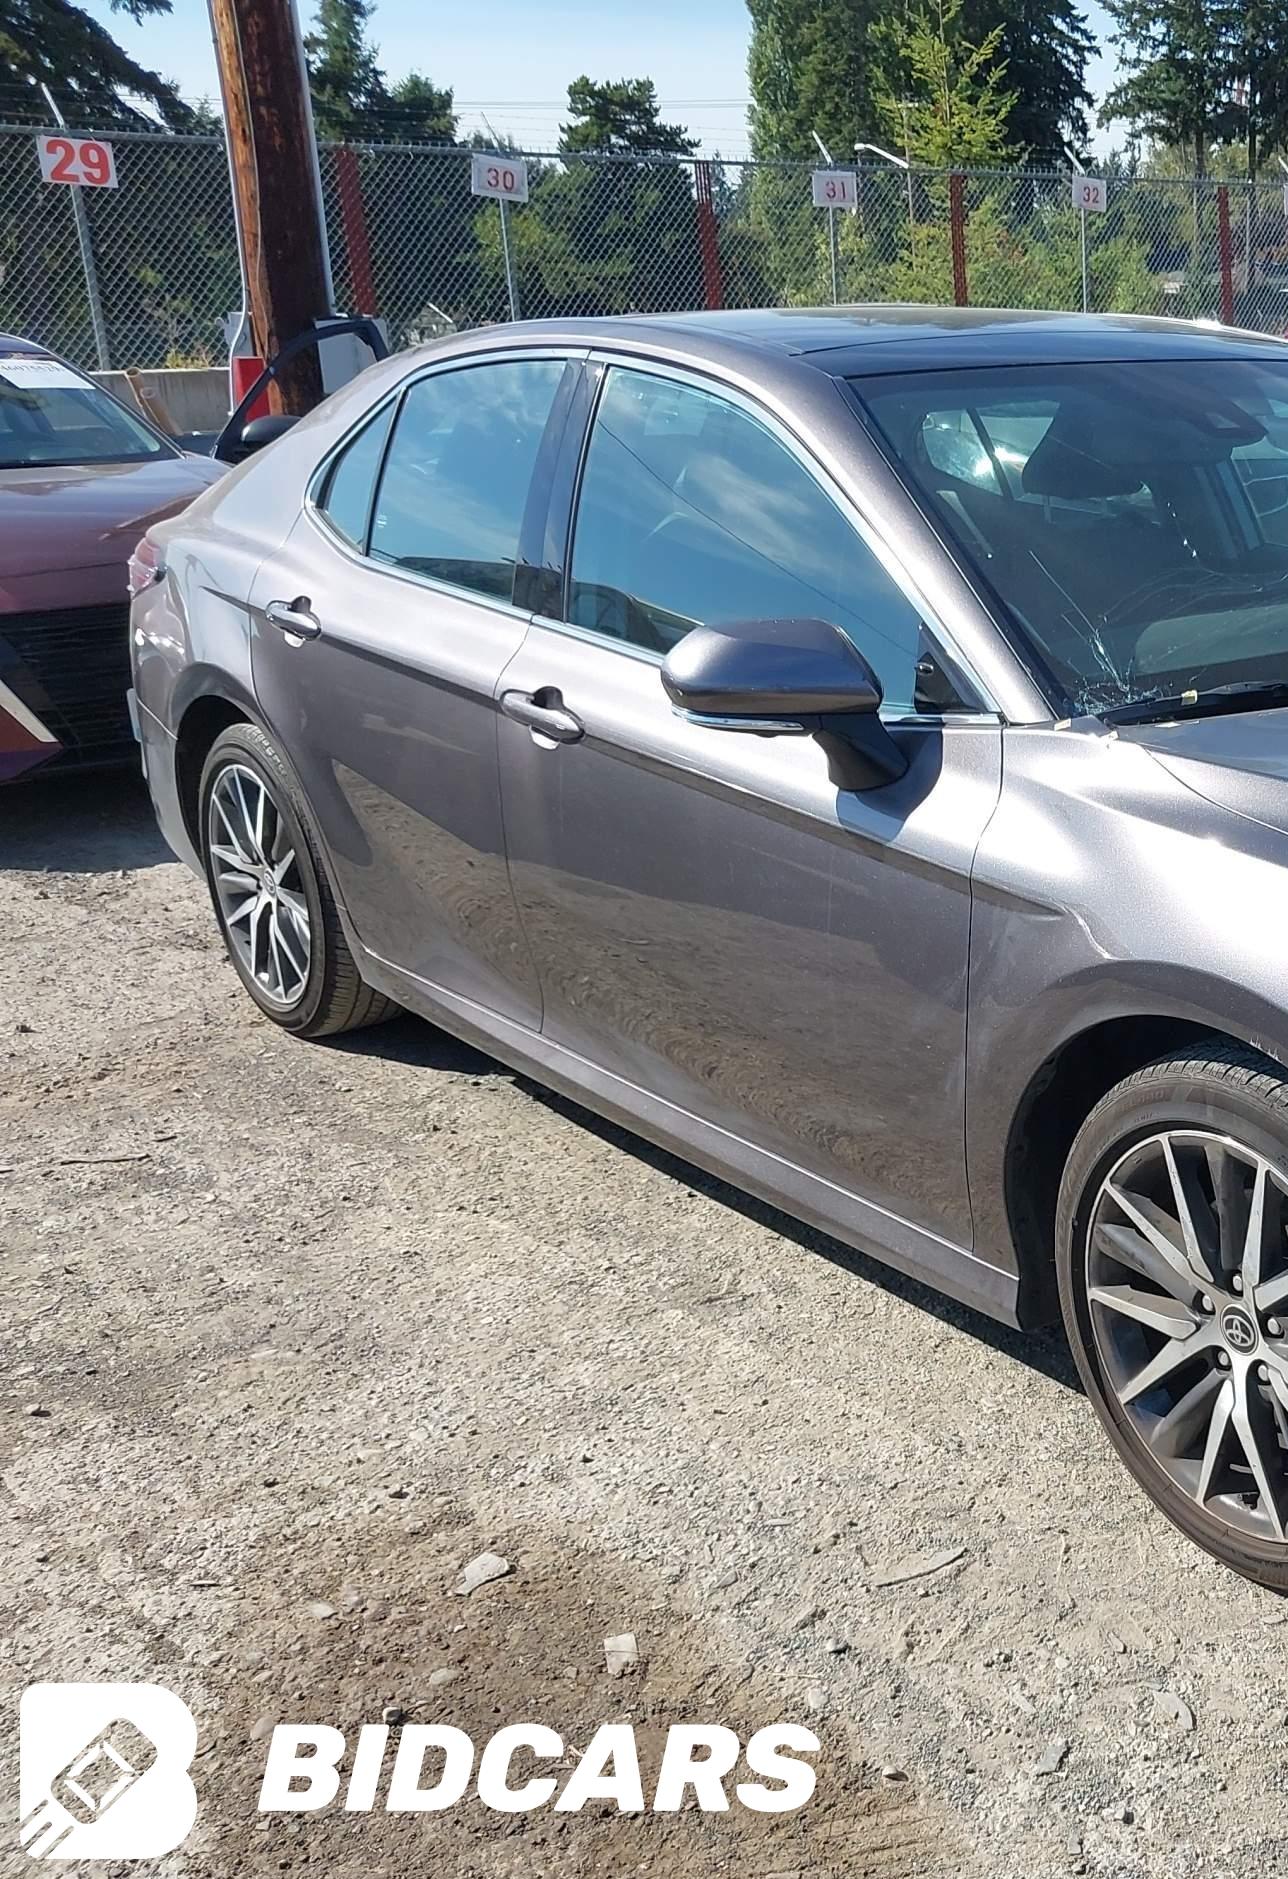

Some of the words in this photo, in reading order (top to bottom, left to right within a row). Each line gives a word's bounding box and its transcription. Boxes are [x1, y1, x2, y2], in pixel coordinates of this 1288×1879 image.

[46, 139, 111, 185] 29
[487, 167, 514, 191] 30
[825, 180, 846, 199] 31
[1083, 186, 1100, 204] 32
